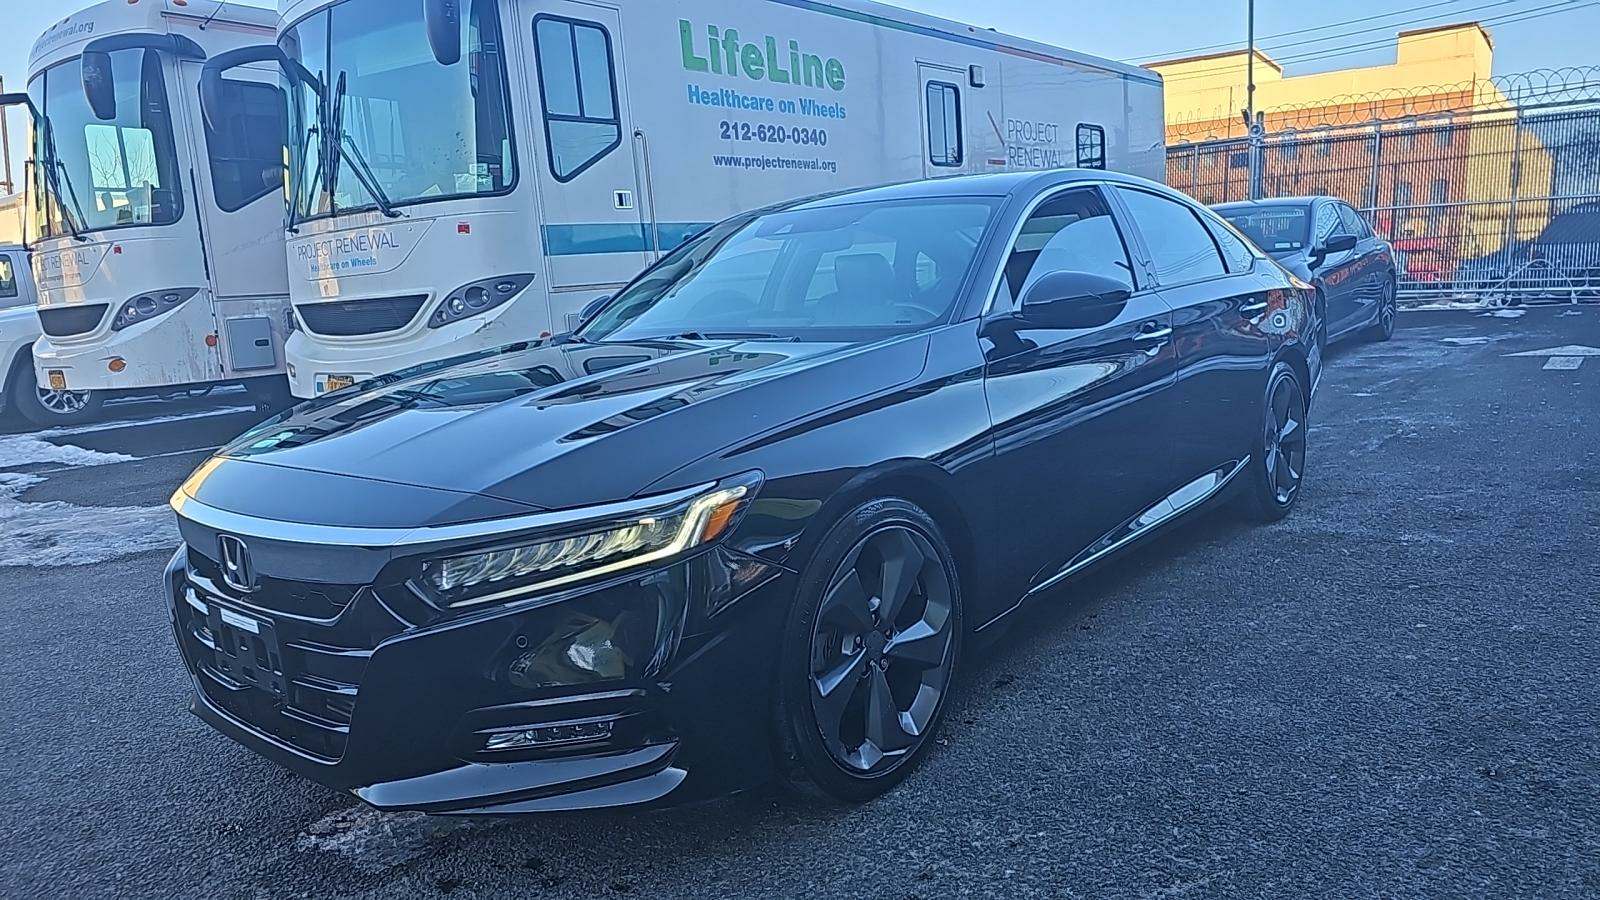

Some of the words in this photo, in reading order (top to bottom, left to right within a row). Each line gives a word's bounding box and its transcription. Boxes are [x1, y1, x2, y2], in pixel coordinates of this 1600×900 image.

[678, 19, 846, 91] LifeLine
[687, 84, 774, 111] Healthcare
[778, 99, 796, 114] on
[799, 98, 846, 119] Wheels
[720, 120, 827, 146] 212-620-0340
[1007, 119, 1058, 143] PROJECT
[713, 155, 837, 172] www.projectrenewal.org
[1008, 146, 1063, 169] RENEWAL
[297, 239, 334, 261] PROJECT
[336, 231, 400, 254] RENEWAL
[341, 260, 350, 268] on
[350, 256, 377, 268] Wheels
